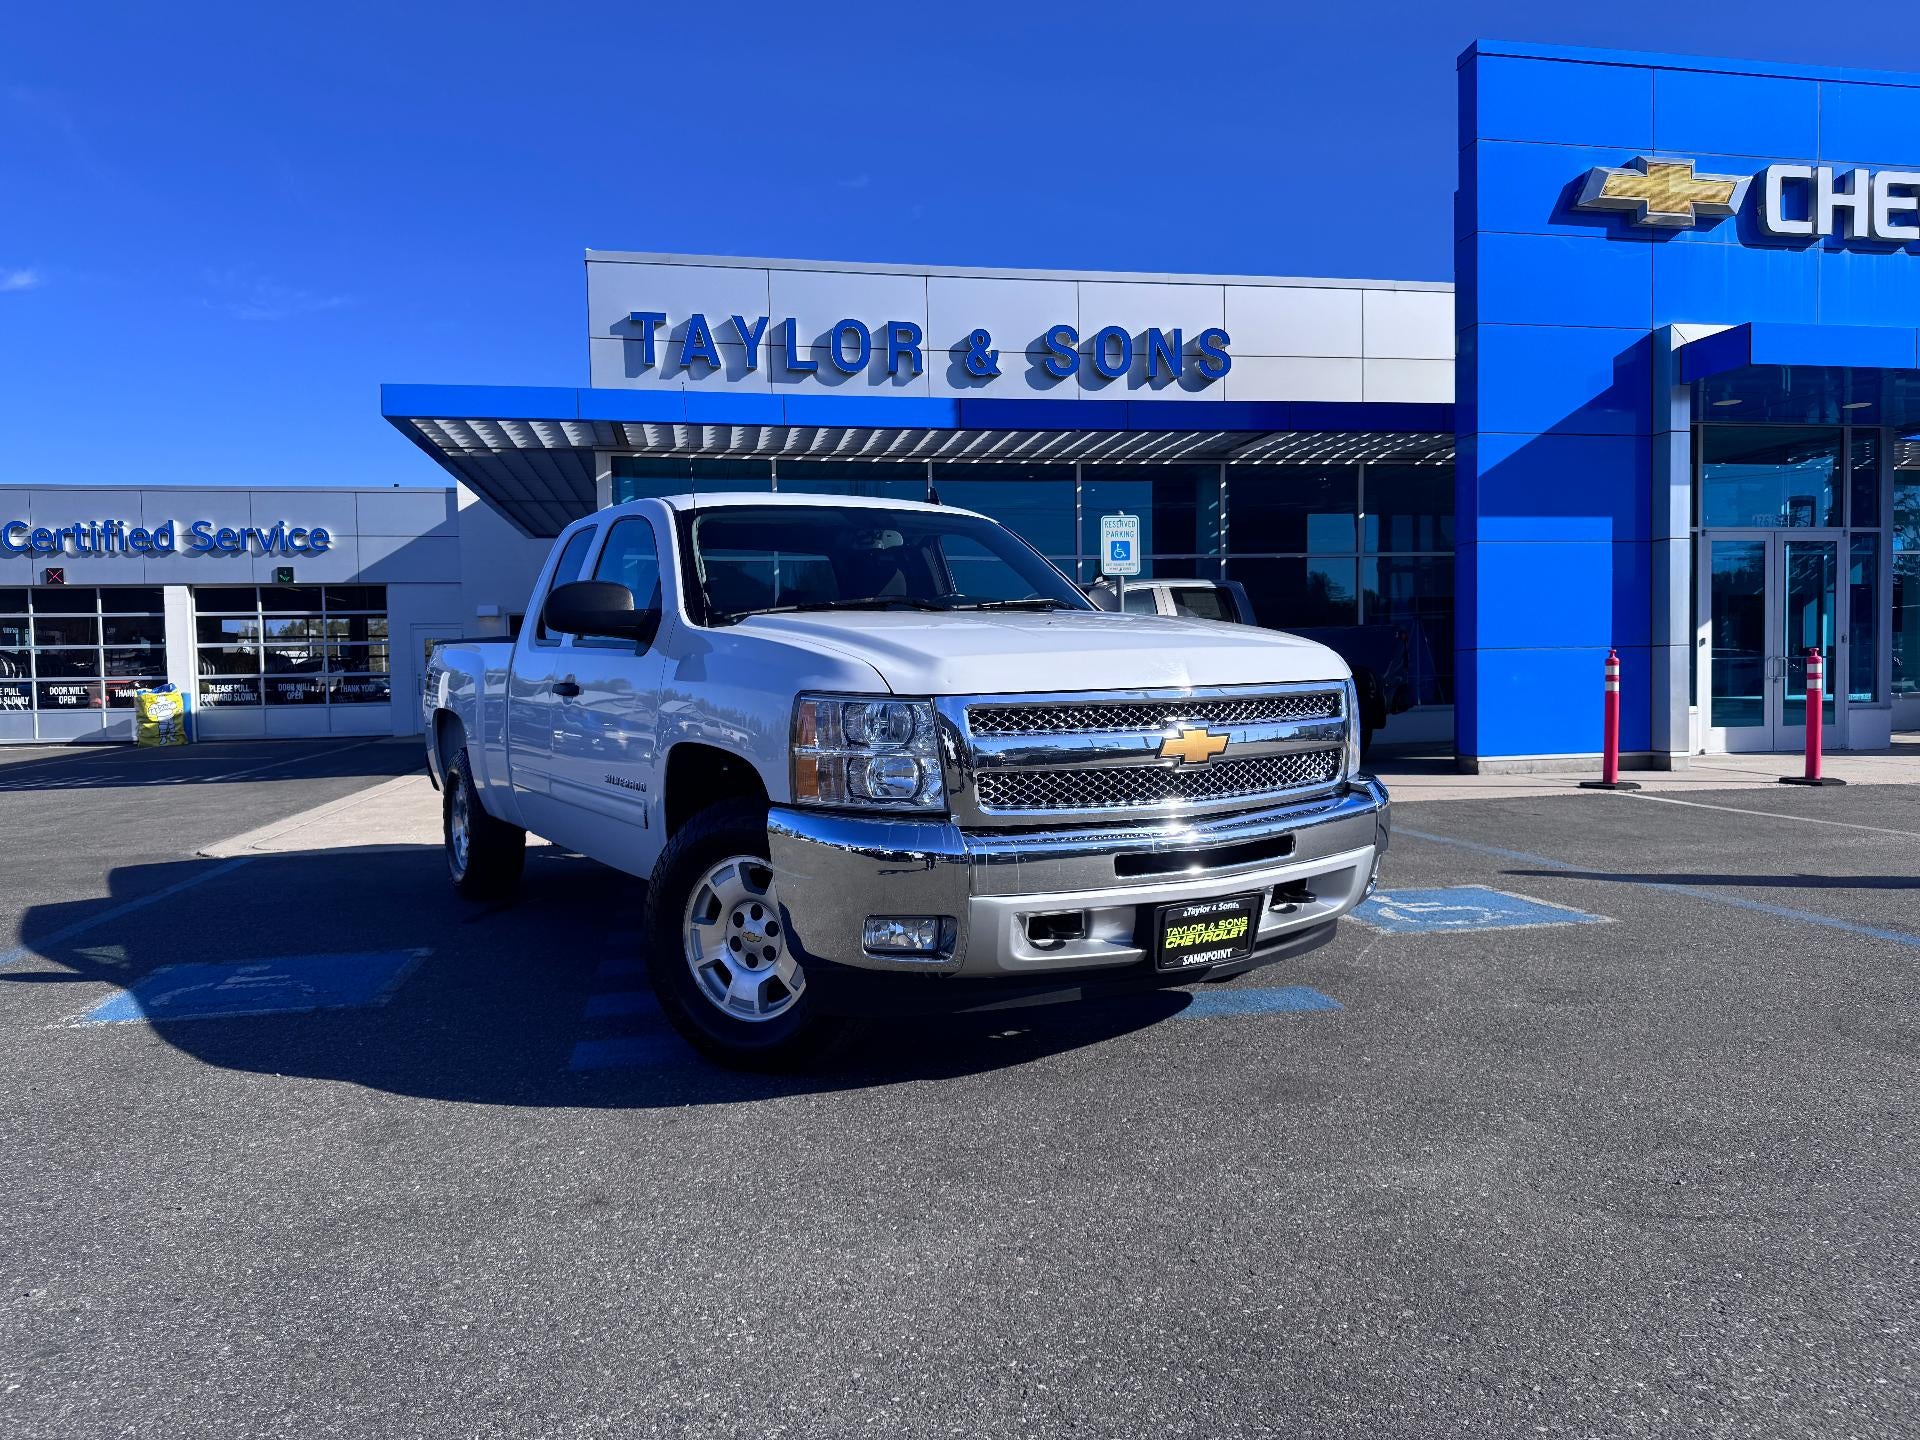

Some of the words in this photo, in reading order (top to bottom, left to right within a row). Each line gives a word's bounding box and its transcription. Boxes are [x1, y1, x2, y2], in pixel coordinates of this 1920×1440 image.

[1765, 164, 1920, 240] CHE
[630, 311, 924, 376] TAYLOR
[964, 328, 1002, 377] &
[1045, 324, 1232, 380] SONS
[1104, 520, 1136, 529] RESERVED
[2, 519, 176, 551] Certified
[190, 520, 331, 551] Service
[1105, 530, 1135, 538] PARKING
[49, 686, 69, 695] DOOR
[69, 686, 86, 695] WILL
[208, 684, 233, 693] PLEASE
[234, 684, 250, 693] PULL
[296, 682, 312, 691] WILL
[340, 684, 360, 693] THANK
[4, 687, 22, 696] PULL
[287, 691, 304, 700] OPEN
[4, 696, 30, 705] SLOWLY
[58, 696, 77, 705] OPEN
[200, 693, 232, 702] FORWARD
[234, 693, 258, 702] SLOWLY
[1187, 904, 1210, 917] Taylor
[1218, 902, 1236, 911] Sons
[1166, 923, 1206, 937] TAYLOR
[1208, 922, 1216, 931] &
[1218, 916, 1248, 927] SONS
[1165, 926, 1248, 949] CHEVROLET
[1182, 948, 1233, 966] SANDPOINT
